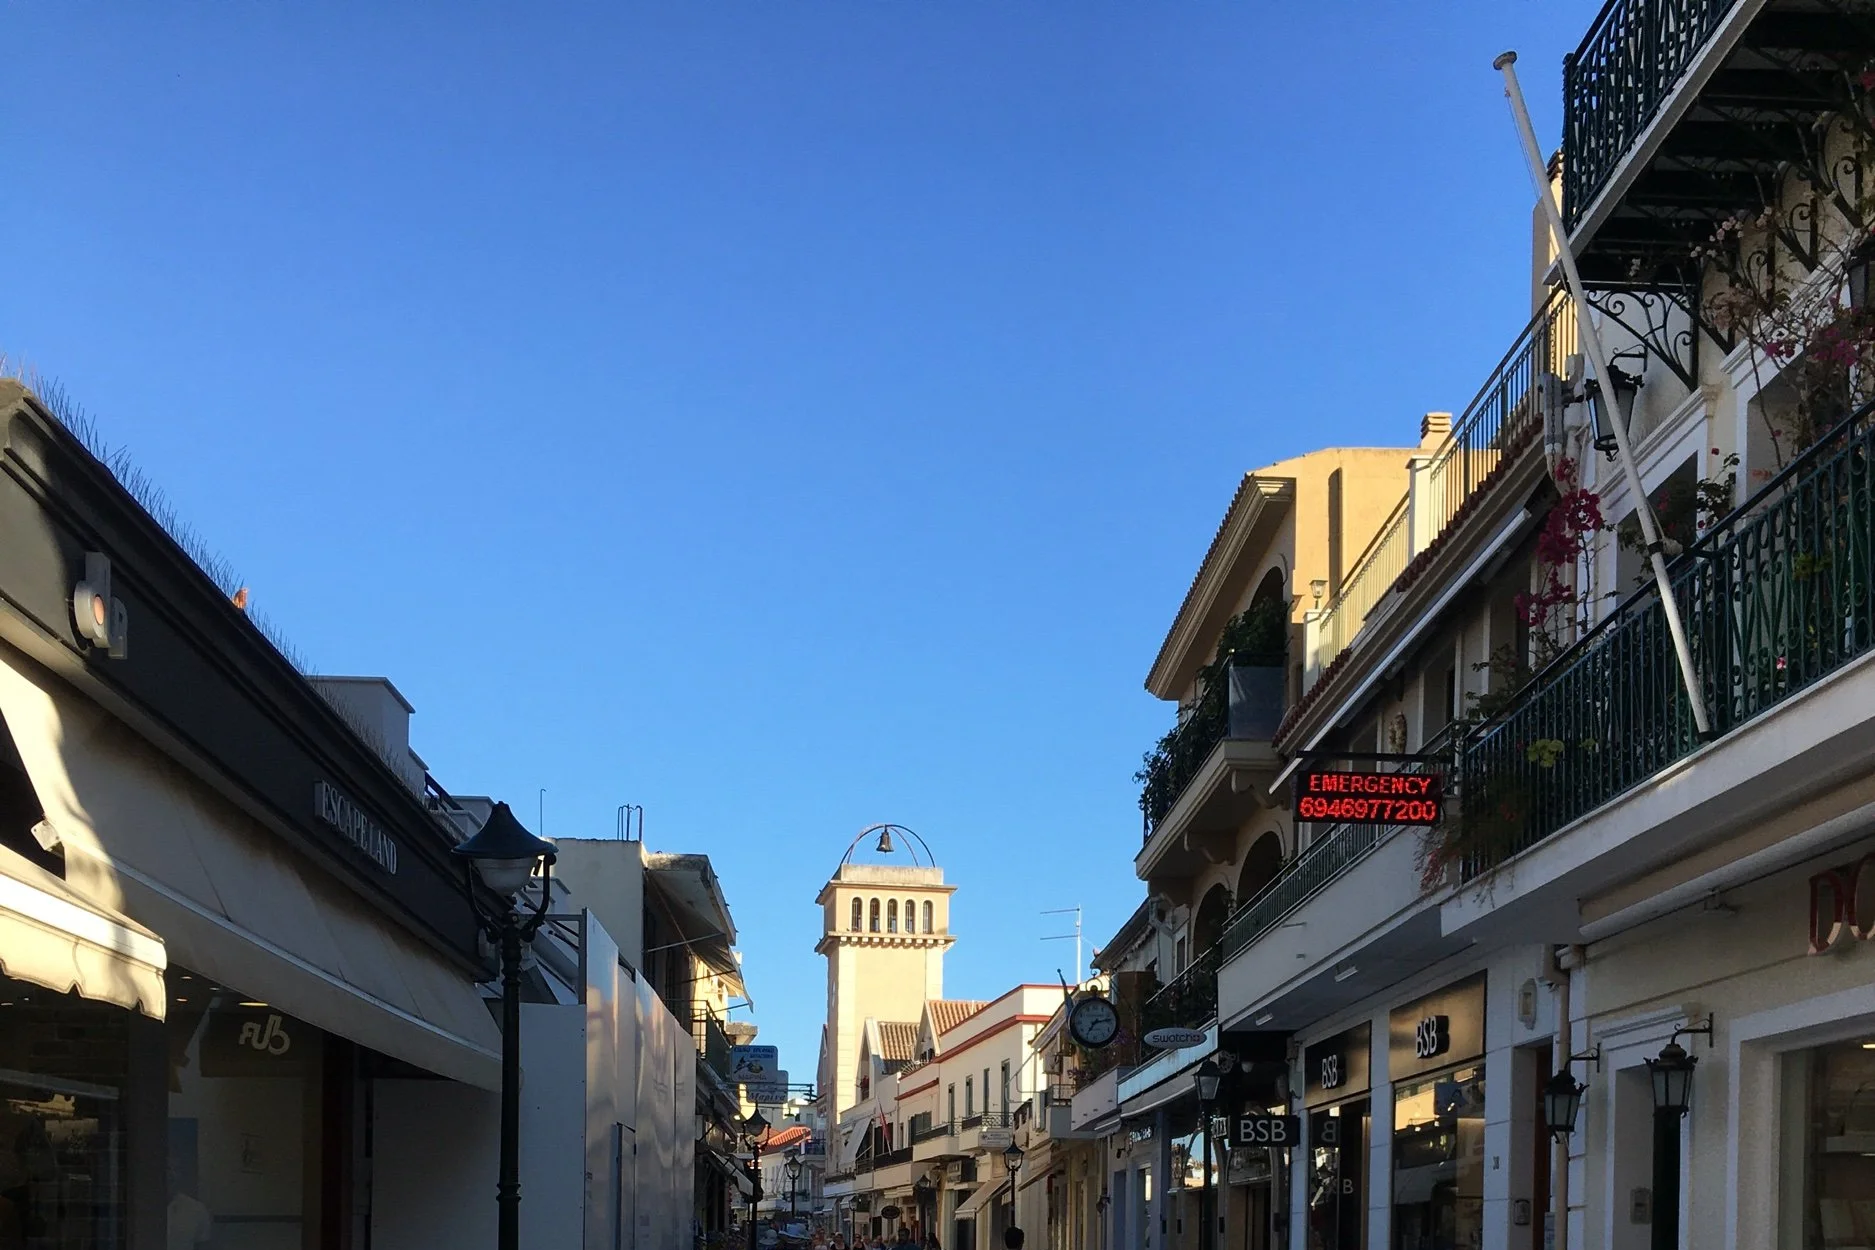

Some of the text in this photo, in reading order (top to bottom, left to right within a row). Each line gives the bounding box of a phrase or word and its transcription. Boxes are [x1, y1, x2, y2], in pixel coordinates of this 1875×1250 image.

[1309, 774, 1431, 795] EMERGENCY
[1299, 797, 1437, 821] 6946977200
[1152, 1032, 1193, 1044] swatch
[1416, 1015, 1439, 1059] BSB
[1321, 1054, 1339, 1090] BSB
[1240, 1119, 1287, 1142] BSB
